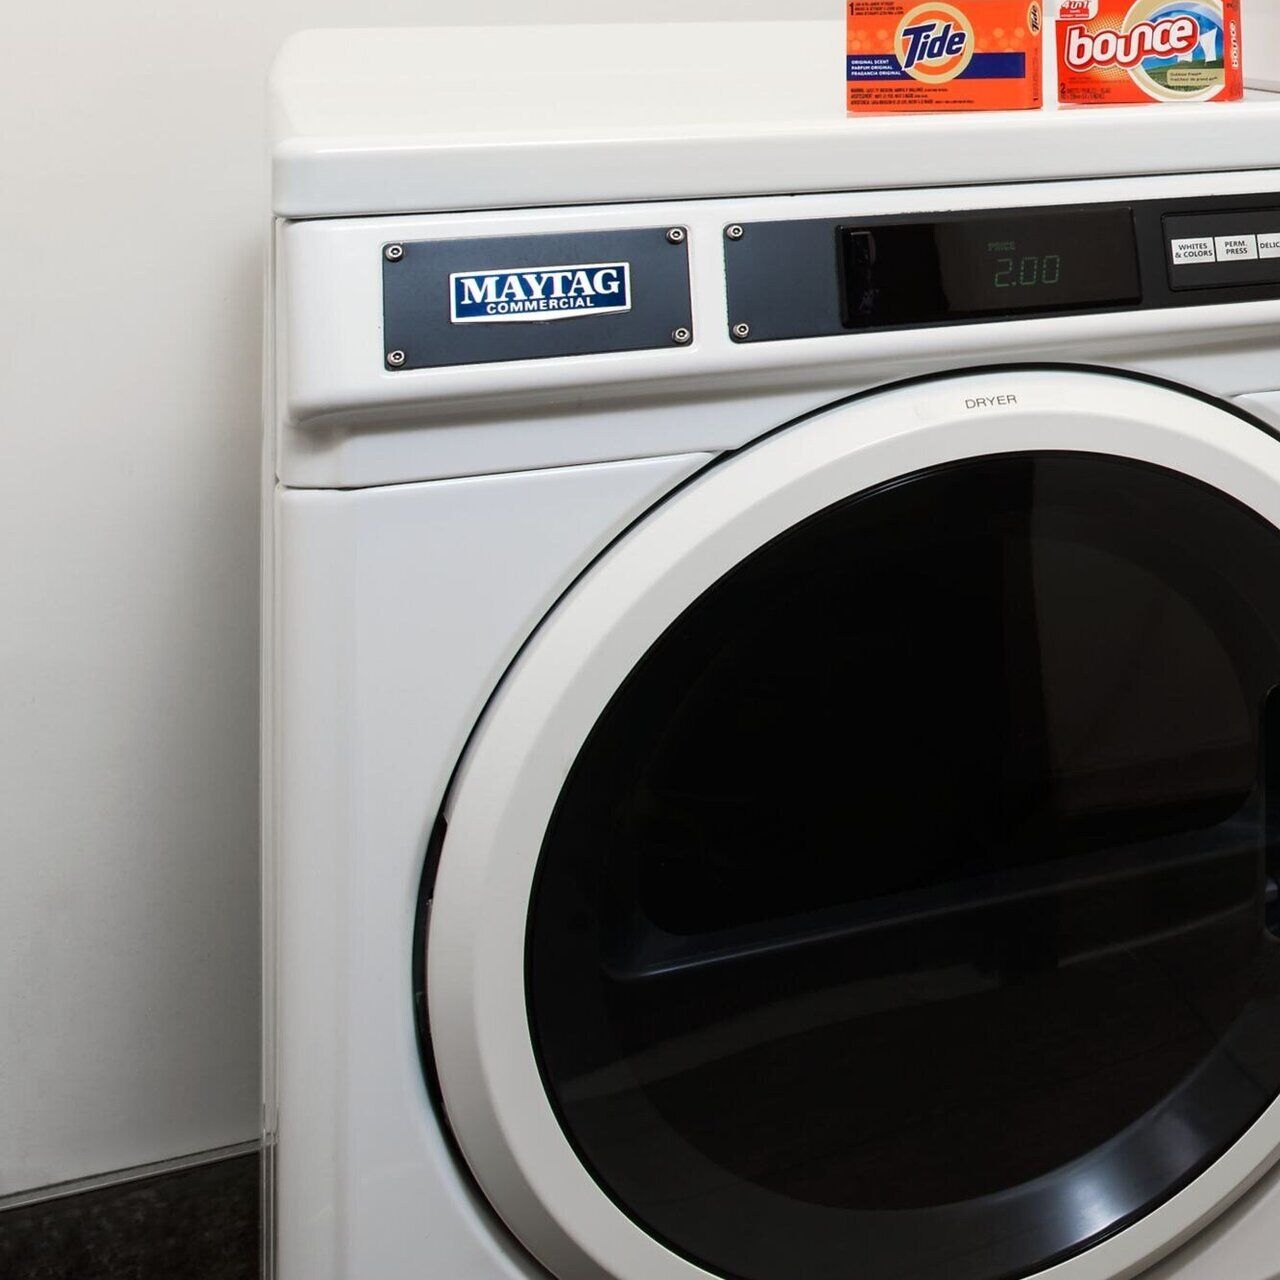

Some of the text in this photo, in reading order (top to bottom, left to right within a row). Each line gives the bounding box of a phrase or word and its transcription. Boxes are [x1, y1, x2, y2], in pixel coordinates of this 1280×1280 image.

[1032, 5, 1040, 31] Tide
[902, 22, 967, 71] Tide
[1067, 18, 1194, 66] bounce
[1183, 250, 1213, 258] COLORS
[1225, 247, 1248, 255] PRESS
[994, 255, 1061, 288] 2.00
[460, 269, 620, 305] MAYTAG
[486, 297, 595, 314] COMMERCIAL
[965, 394, 1017, 409] DRYER
